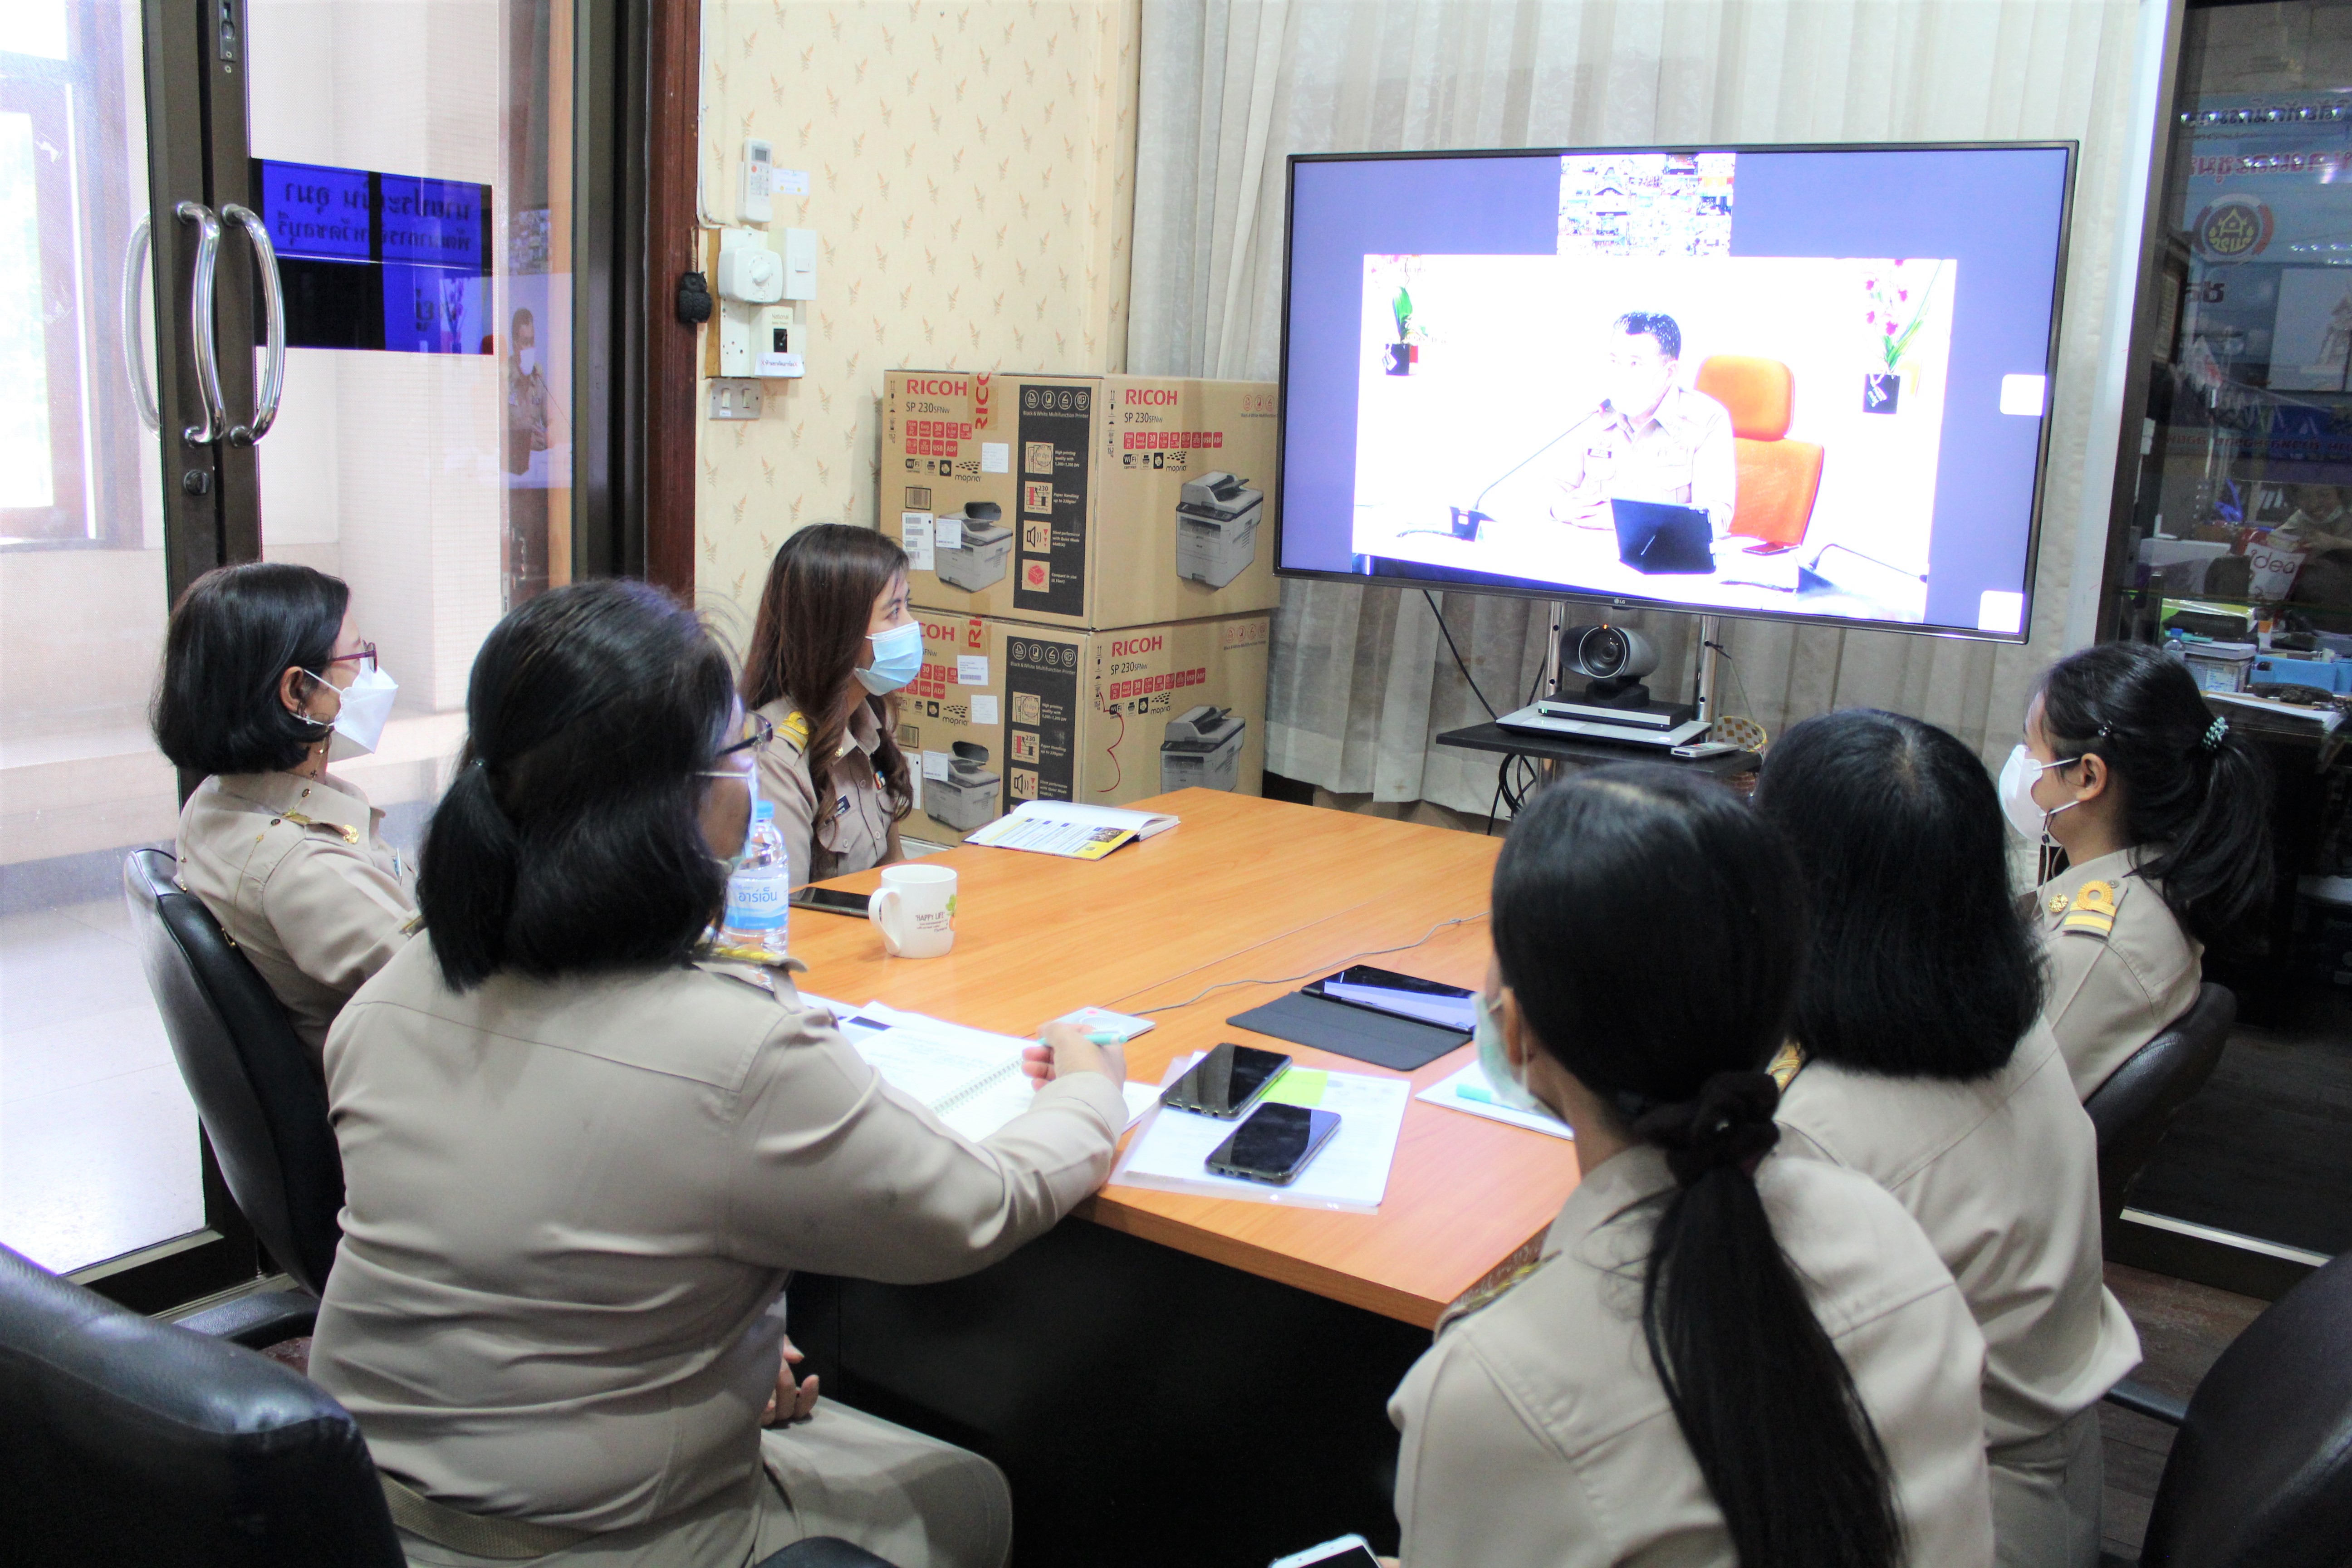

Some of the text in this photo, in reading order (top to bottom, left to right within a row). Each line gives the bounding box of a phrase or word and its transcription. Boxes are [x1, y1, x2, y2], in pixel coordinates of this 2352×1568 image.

[907, 379, 967, 396] RICOH
[1125, 389, 1177, 405] RICOH
[906, 402, 916, 412] SP
[1124, 412, 1133, 423] SP
[955, 474, 980, 483] mopria
[920, 622, 955, 641] COH
[1112, 636, 1162, 657] RICOH
[1111, 665, 1119, 675] SP
[1151, 706, 1171, 715] mopria
[942, 716, 968, 726] mopria
[739, 887, 777, 902] อาร์เอ็น
